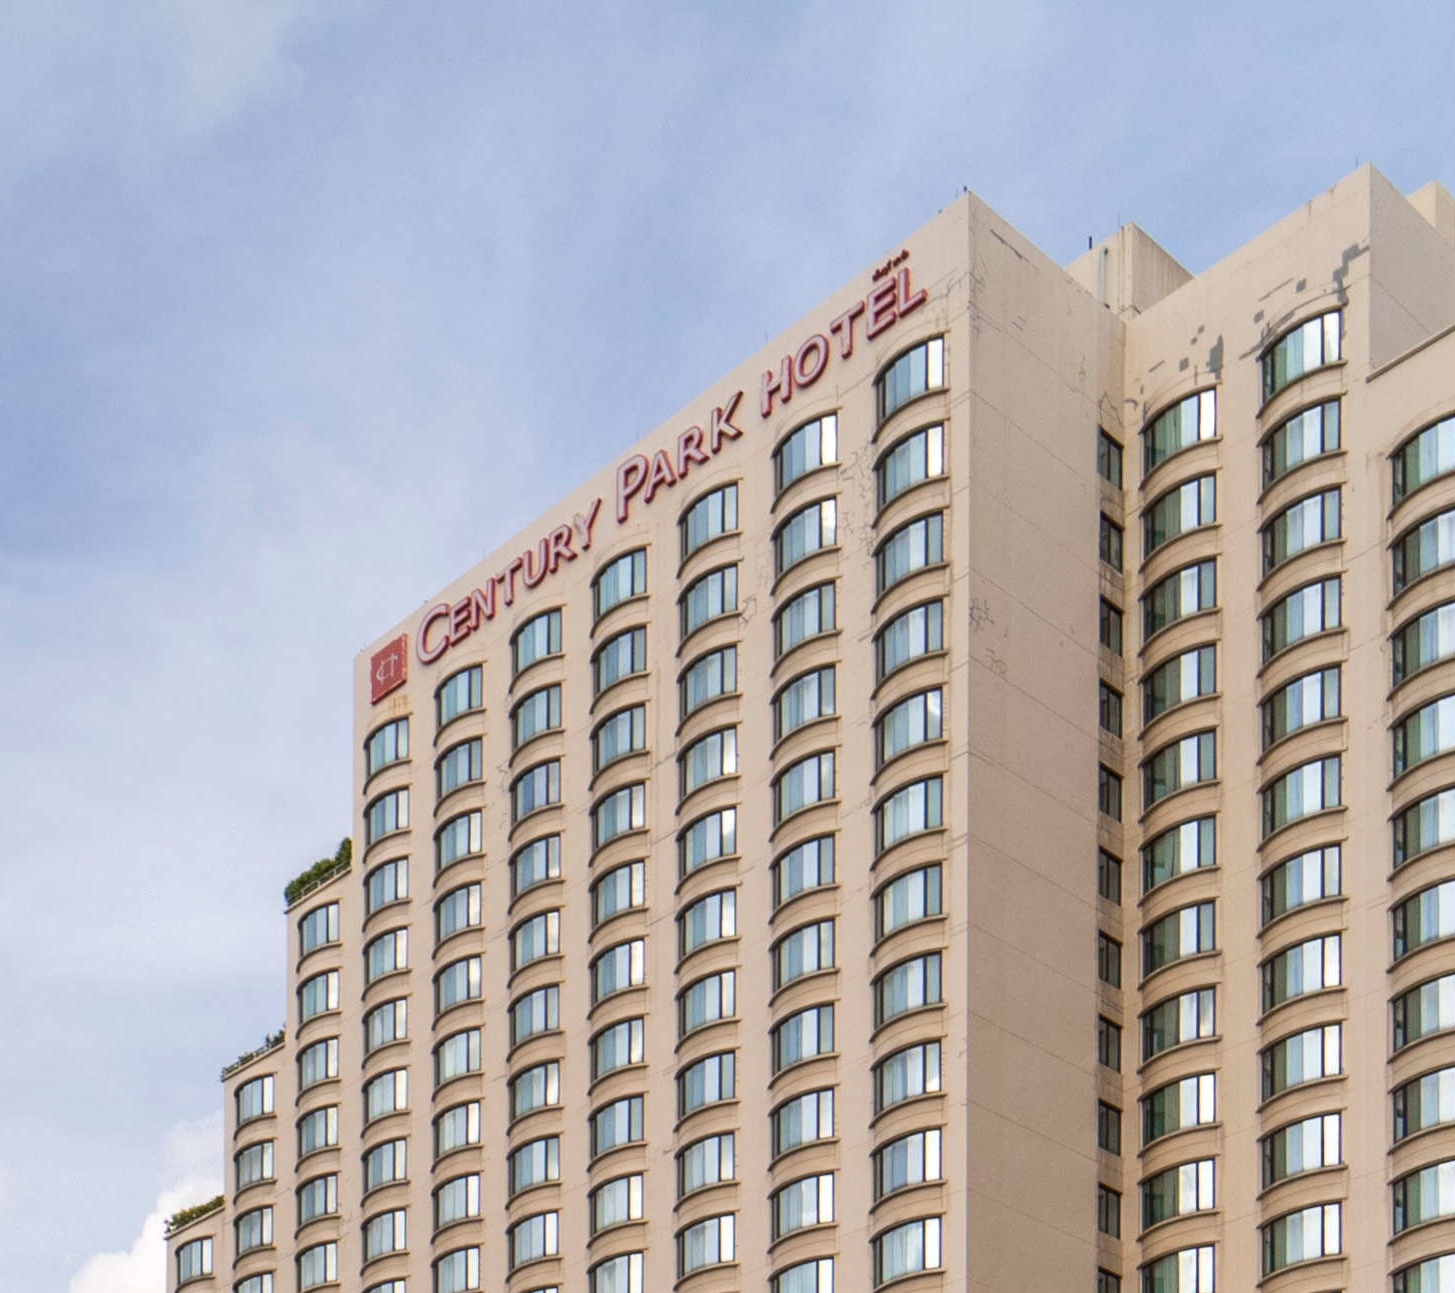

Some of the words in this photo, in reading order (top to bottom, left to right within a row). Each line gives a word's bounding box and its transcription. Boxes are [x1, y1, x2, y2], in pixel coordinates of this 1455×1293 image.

[415, 498, 602, 664] CENTURY
[615, 392, 743, 523] PARK
[759, 267, 927, 416] HOTEL
